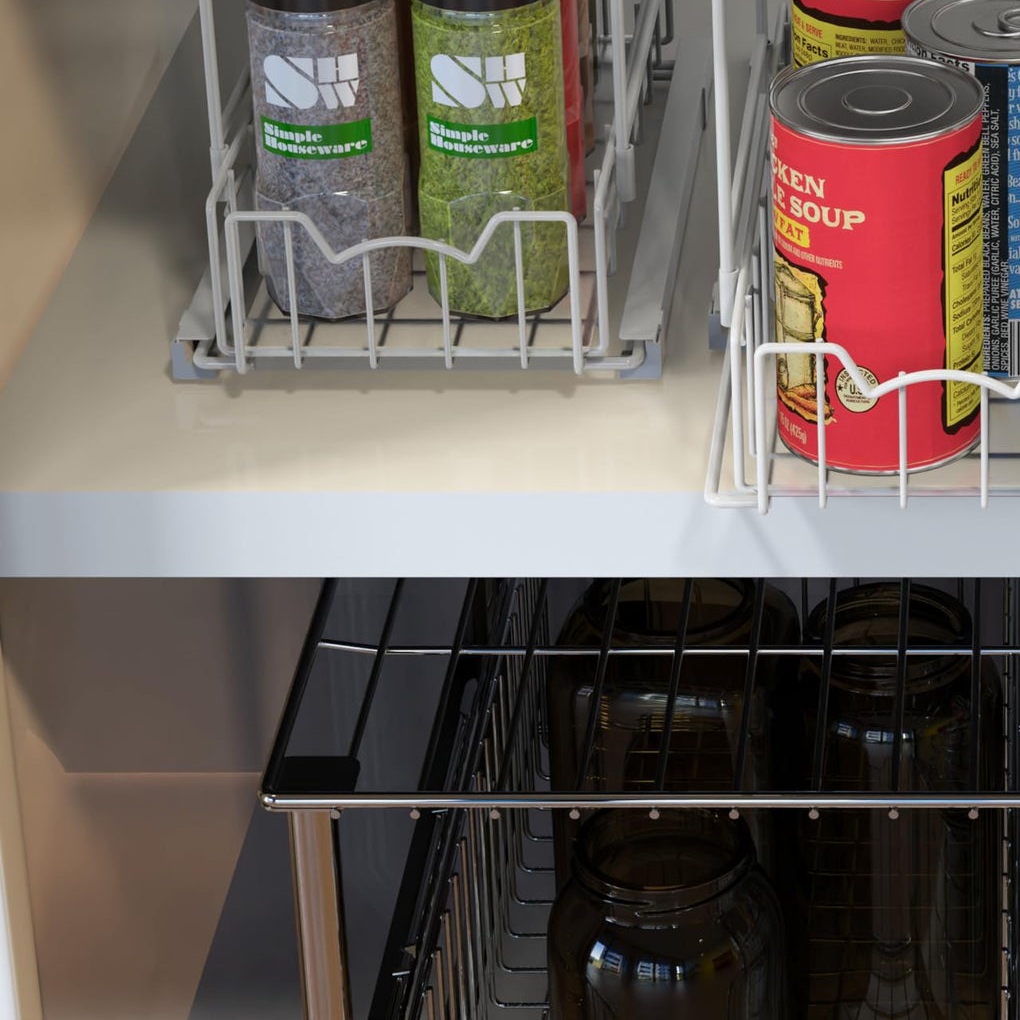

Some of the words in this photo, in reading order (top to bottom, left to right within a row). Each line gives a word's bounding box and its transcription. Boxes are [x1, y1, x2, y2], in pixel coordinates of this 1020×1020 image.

[801, 36, 829, 59] Facts
[990, 108, 1000, 131] SALT,
[263, 122, 323, 144] Simple
[429, 121, 490, 142] Simple
[982, 125, 990, 146] BELL
[990, 132, 1000, 149] SEA
[264, 134, 368, 155] Houseware
[430, 133, 534, 154] Houseware
[991, 177, 1000, 206] CITRIC
[789, 194, 866, 231] SOUP
[991, 276, 1000, 304] PUREE
[1000, 298, 1009, 320] WINE
[991, 305, 1000, 336] GARLIC
